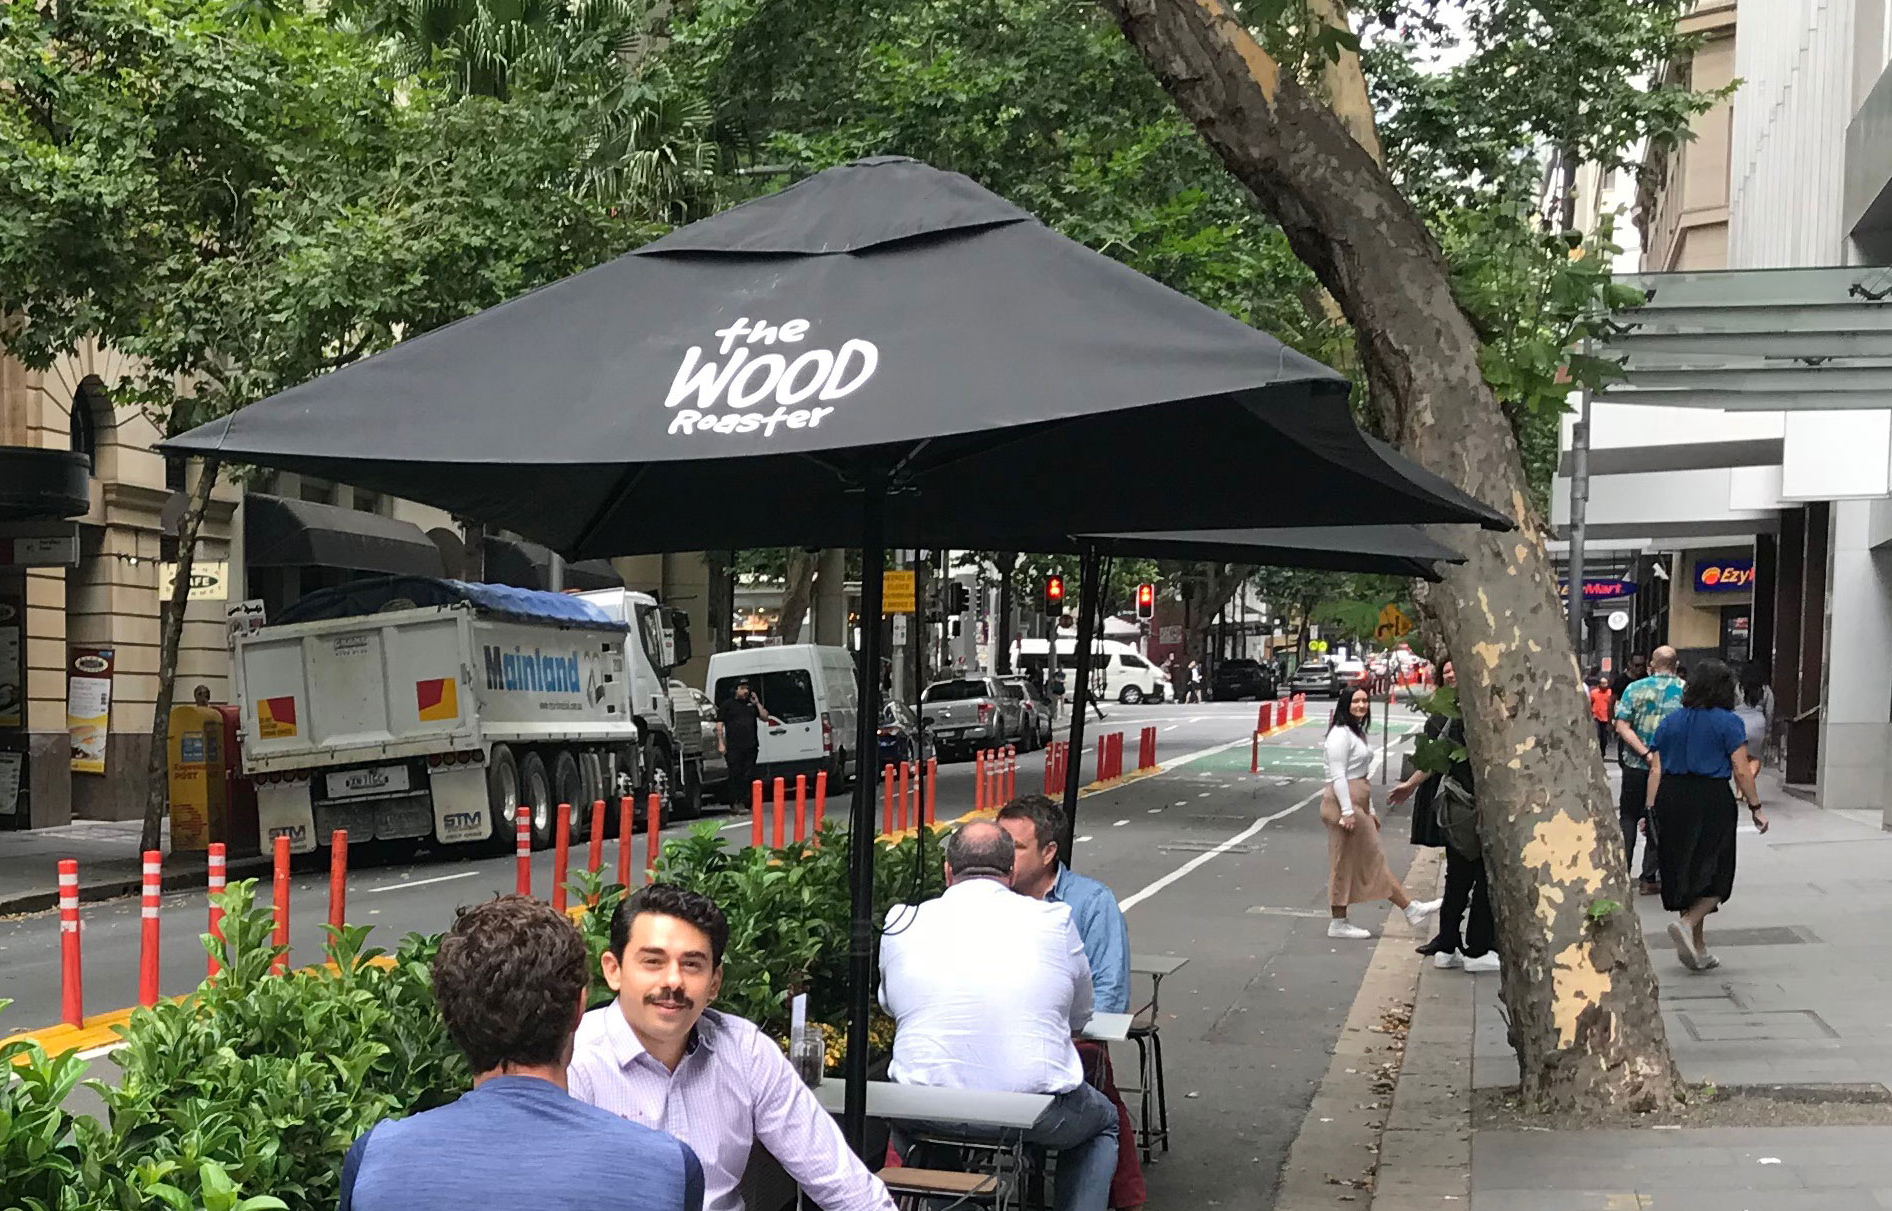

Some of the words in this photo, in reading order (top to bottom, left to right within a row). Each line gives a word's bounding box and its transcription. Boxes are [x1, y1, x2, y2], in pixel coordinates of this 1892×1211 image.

[715, 318, 810, 354] the
[664, 339, 878, 408] WOOD
[668, 407, 834, 437] Roaster
[189, 577, 209, 587] AFE
[483, 645, 581, 692] Mainland
[443, 811, 481, 827] STM
